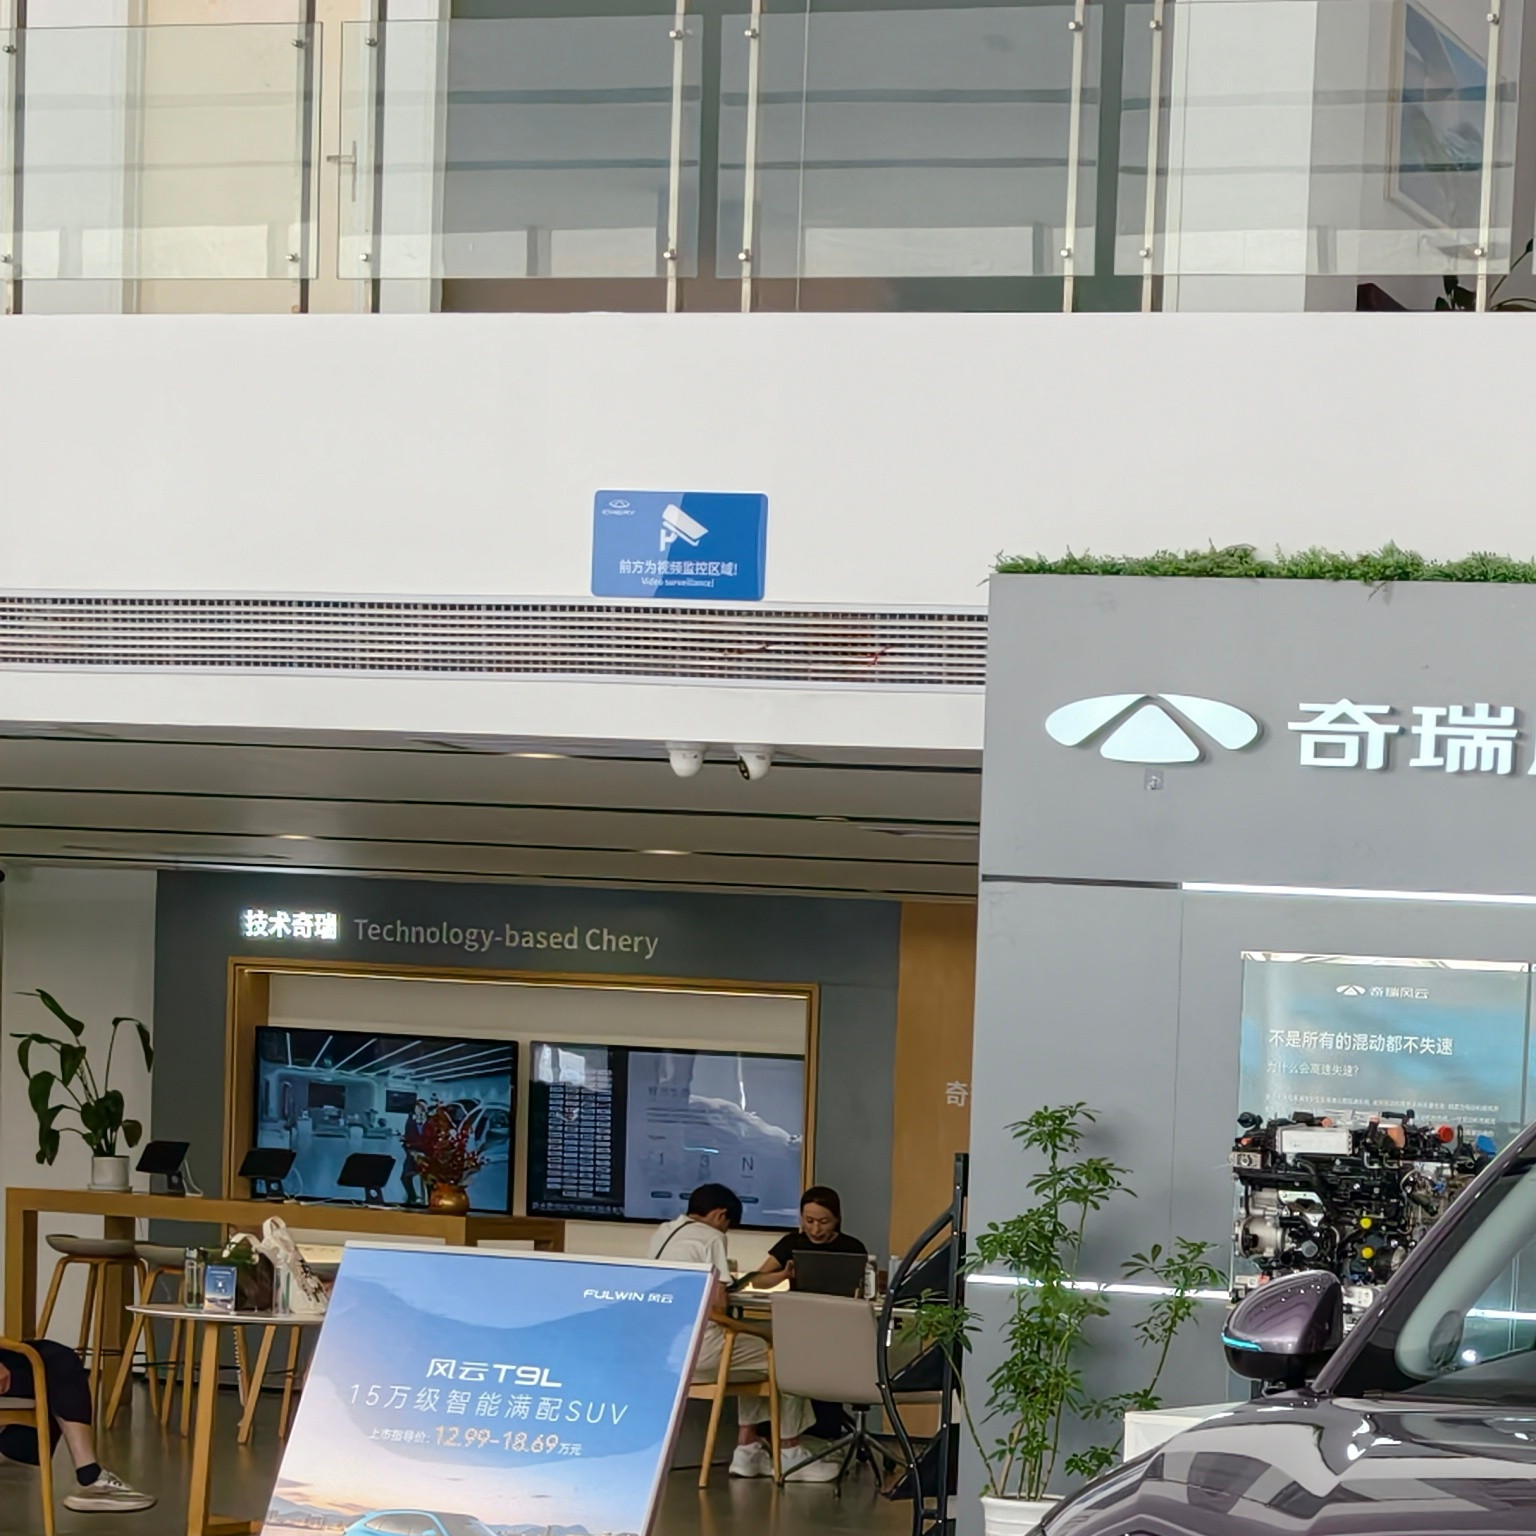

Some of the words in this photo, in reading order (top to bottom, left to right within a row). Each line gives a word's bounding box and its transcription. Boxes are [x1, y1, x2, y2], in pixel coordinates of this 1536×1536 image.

[641, 576, 663, 588] Video
[244, 909, 338, 941] 技术奇瑞
[353, 918, 579, 952] Technology-based
[585, 928, 660, 960] Chery
[1370, 986, 1430, 1000] 奇瑞风云
[1269, 1029, 1454, 1057] 不是所有的混动都不失速
[583, 1288, 645, 1303] FULWIN
[647, 1292, 675, 1304] 风云
[425, 1358, 563, 1388] 风云T9L
[348, 1382, 630, 1426] 15万级智能满配SUV
